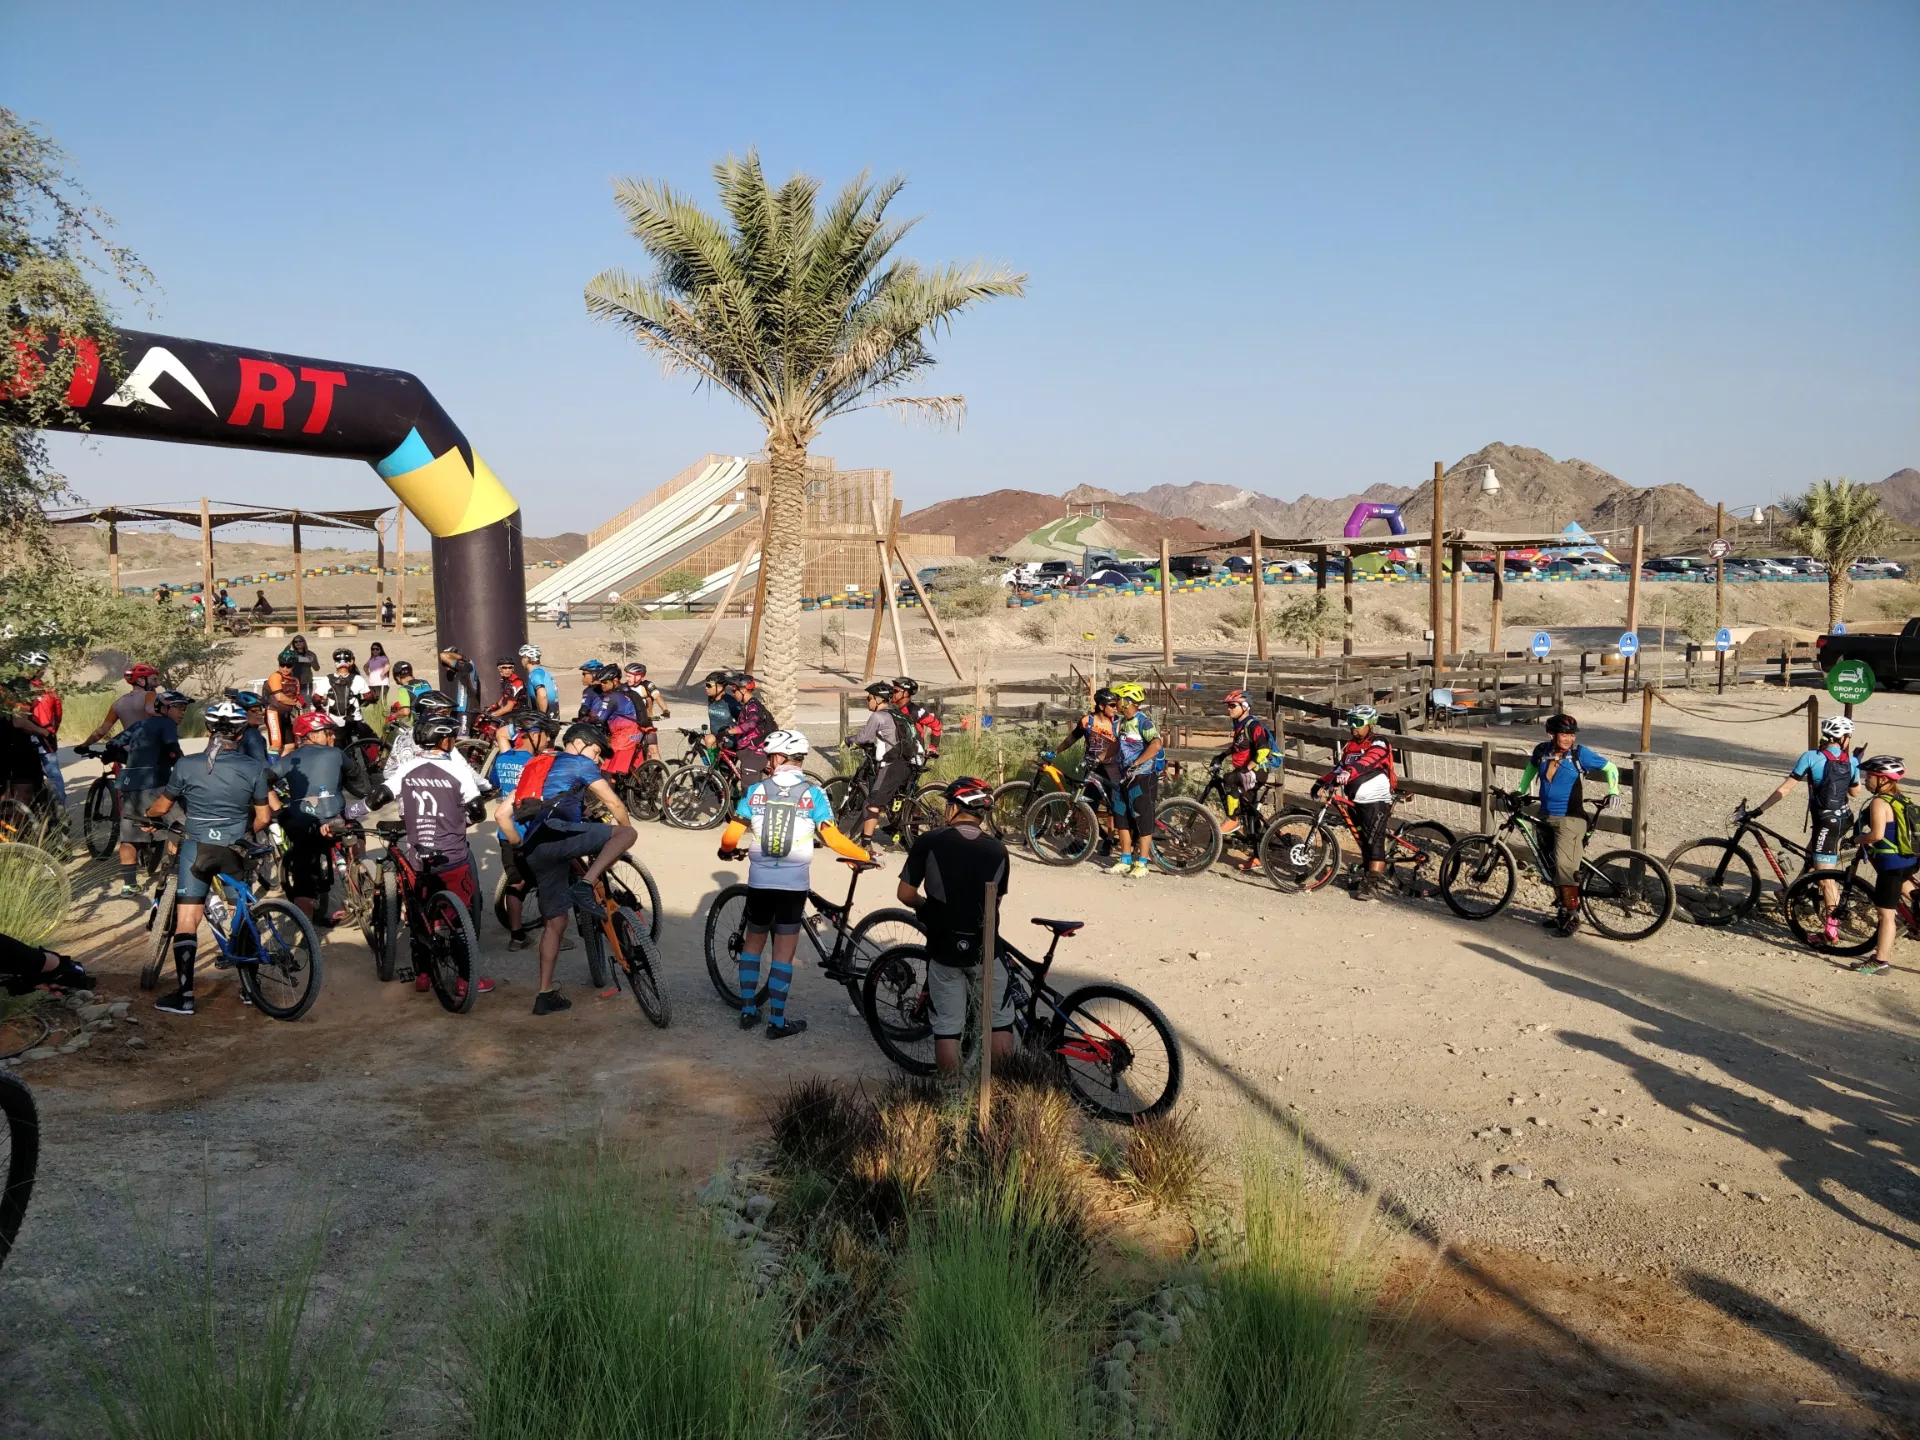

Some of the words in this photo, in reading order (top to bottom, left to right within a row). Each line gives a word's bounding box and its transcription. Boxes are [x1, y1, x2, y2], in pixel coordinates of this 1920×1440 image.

[1834, 685, 1854, 693] DROP
[1839, 692, 1861, 700] POINT
[405, 777, 453, 789] CANYON
[772, 808, 785, 855] NATHAN
[1815, 826, 1830, 853] NISSAN
